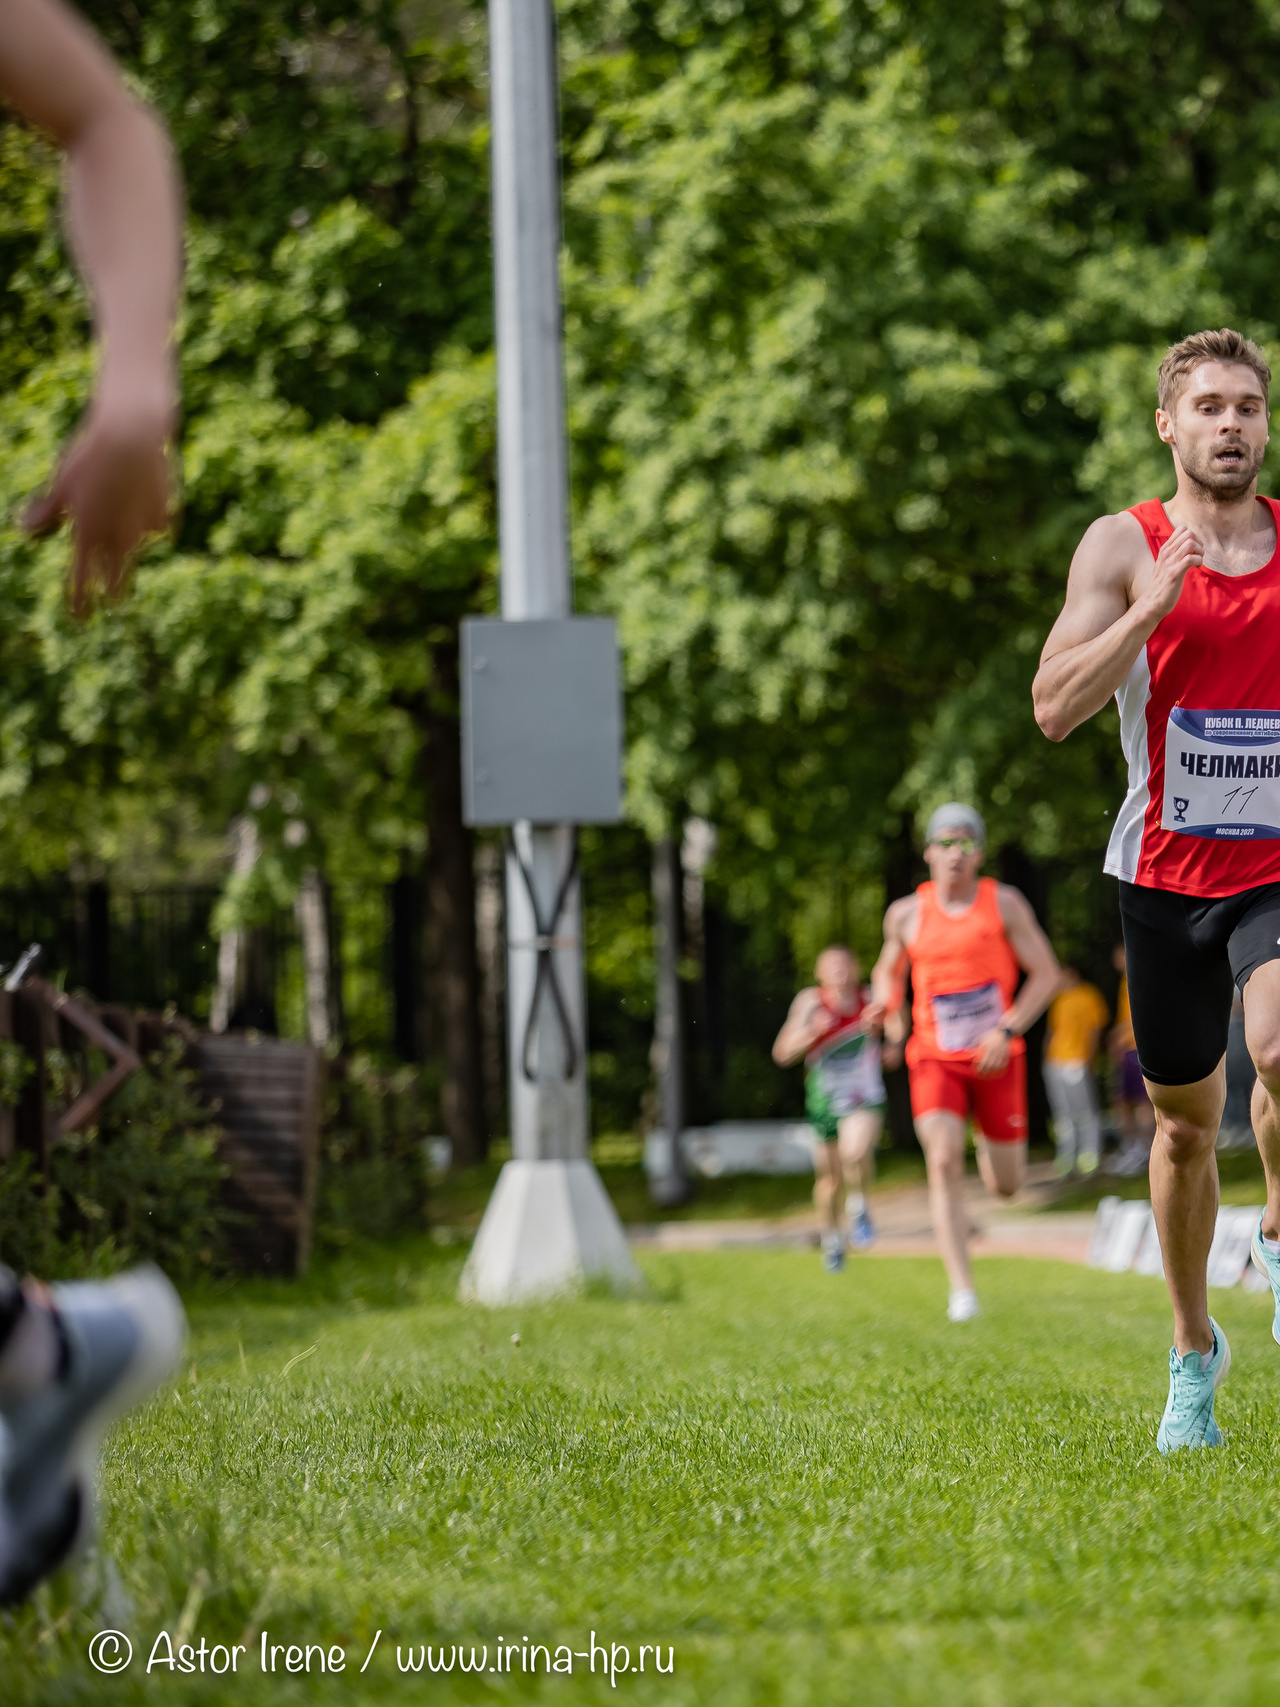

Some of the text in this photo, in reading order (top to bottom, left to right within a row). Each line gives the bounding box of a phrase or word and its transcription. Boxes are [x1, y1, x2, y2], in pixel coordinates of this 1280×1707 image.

[1205, 717, 1234, 729] КУБОК
[1235, 717, 1244, 729] П.
[1221, 785, 1259, 815] 11
[1215, 827, 1255, 836] МОСКВА 2023
